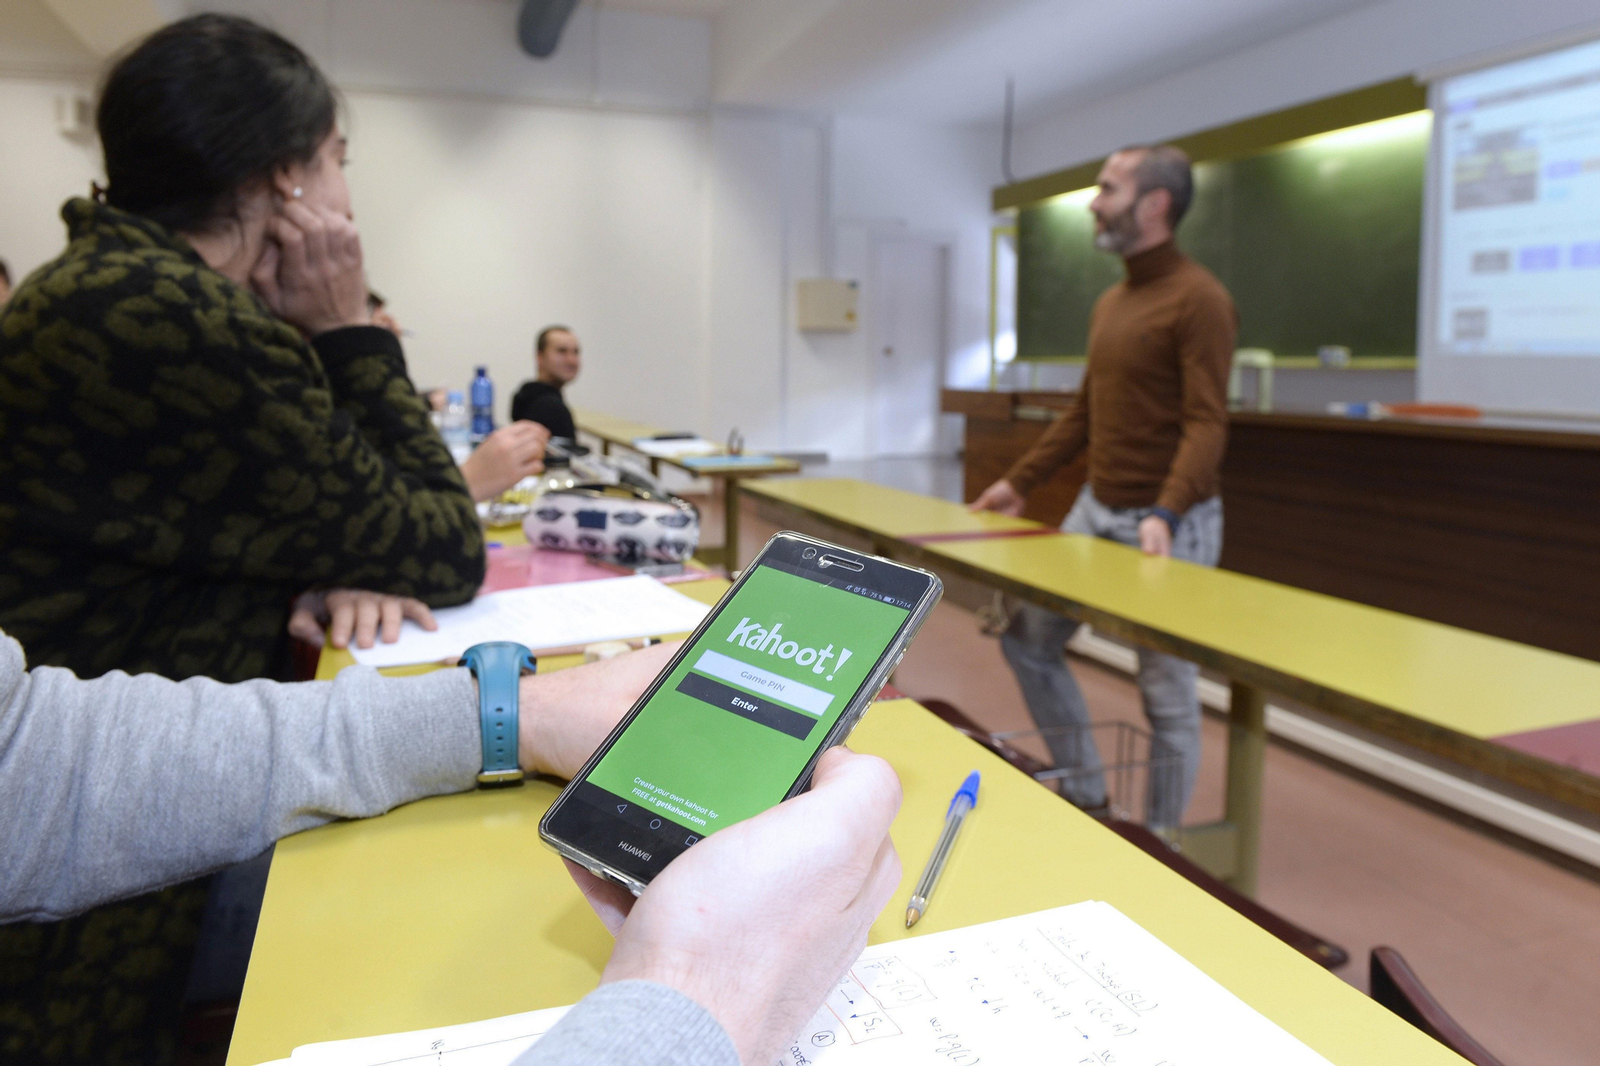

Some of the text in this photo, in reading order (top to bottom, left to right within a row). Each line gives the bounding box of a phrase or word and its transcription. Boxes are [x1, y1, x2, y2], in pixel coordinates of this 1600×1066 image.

[895, 600, 912, 609] 17:14
[726, 617, 853, 682] Kahoot!
[740, 670, 786, 692] Game PIN
[730, 696, 758, 713] Enter
[631, 787, 707, 827] FREE at getkahoot.com
[633, 777, 719, 819] Create your own kahoot for
[618, 840, 652, 862] HUAWEI
